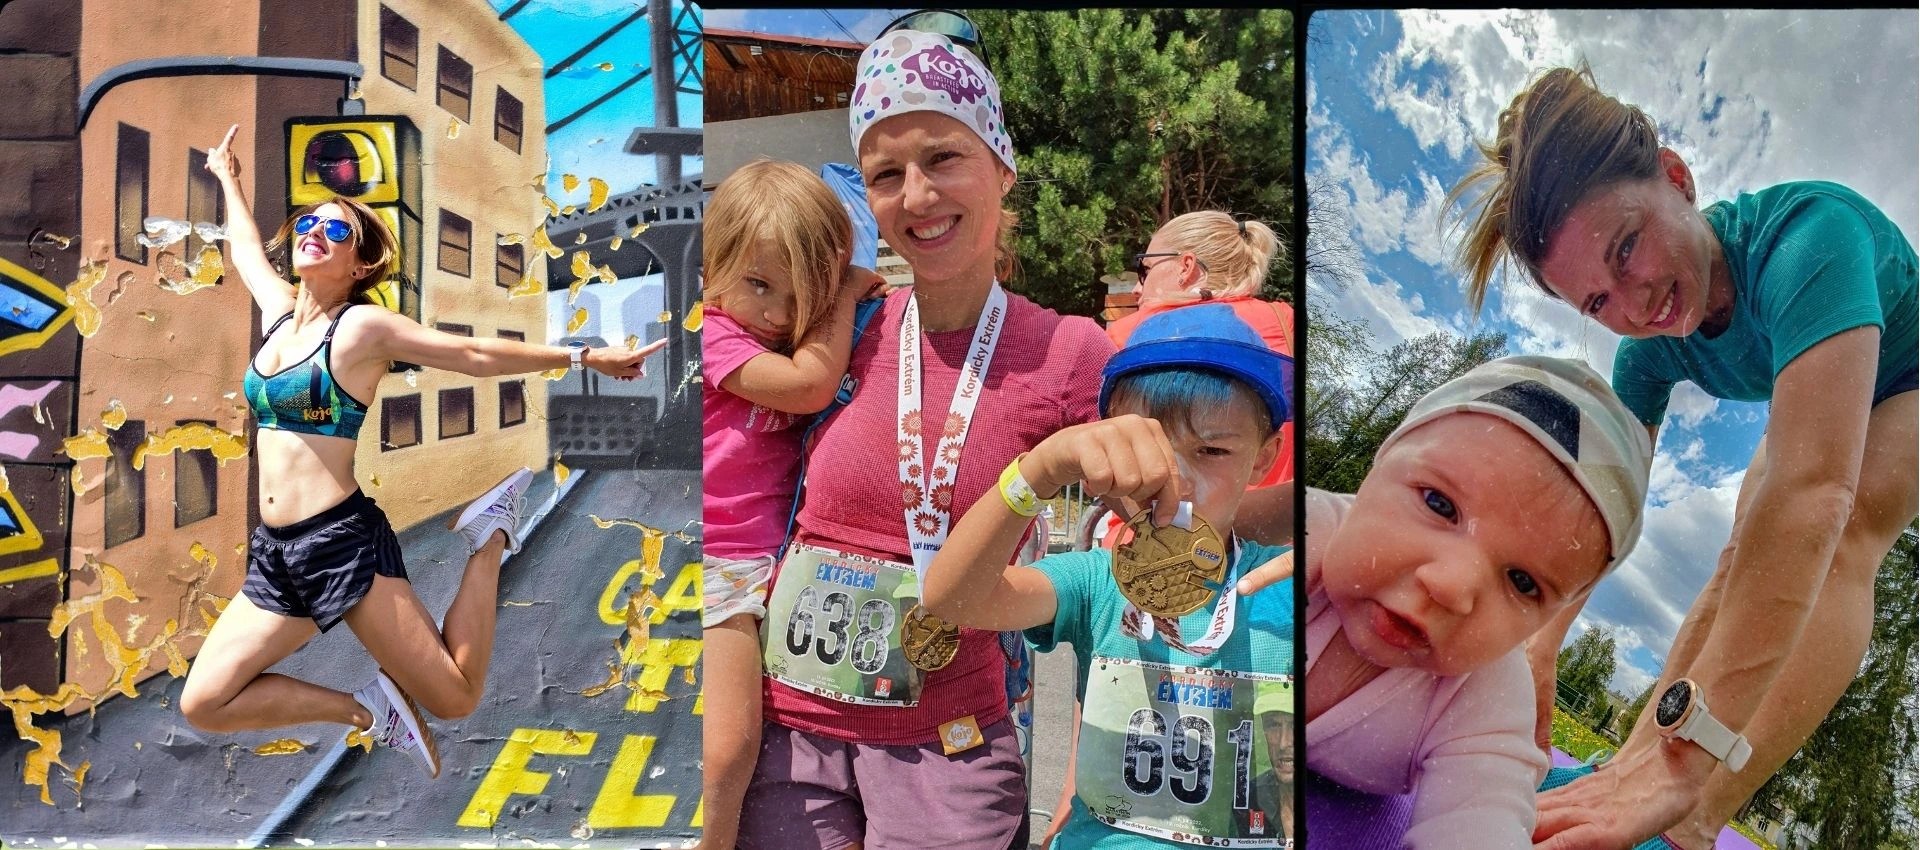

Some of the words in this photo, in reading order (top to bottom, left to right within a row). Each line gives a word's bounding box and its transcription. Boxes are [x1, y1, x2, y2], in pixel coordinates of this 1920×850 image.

[979, 306, 1001, 346] Extrém
[786, 585, 896, 675] 638
[1122, 707, 1254, 810] 691
